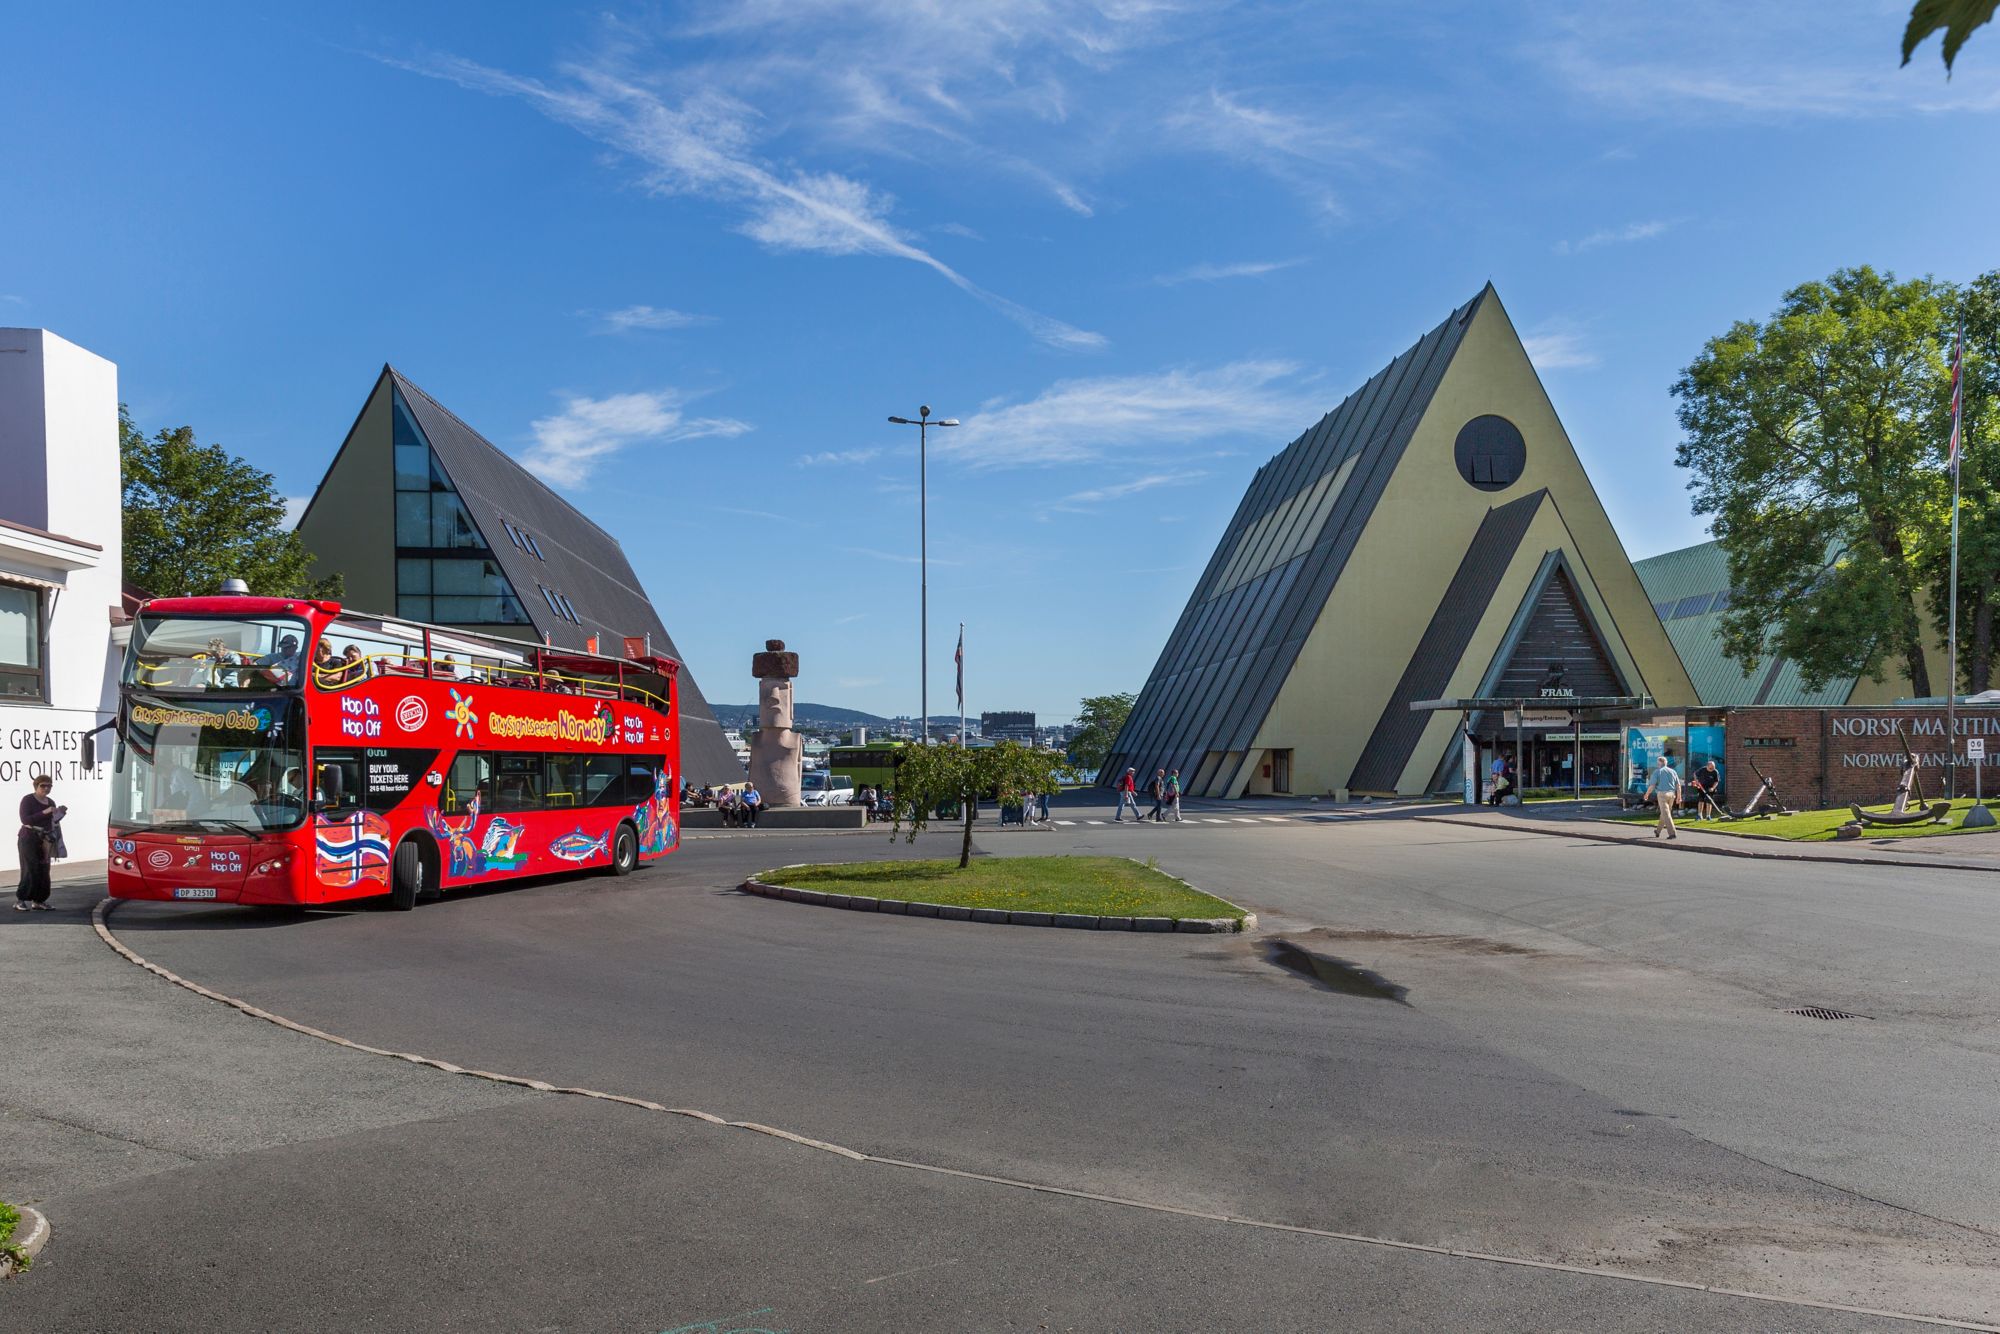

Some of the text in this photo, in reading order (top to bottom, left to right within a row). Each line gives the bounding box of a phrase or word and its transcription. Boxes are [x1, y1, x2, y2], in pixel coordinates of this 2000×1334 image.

[1541, 688, 1573, 697] FRAM
[341, 696, 379, 715] Hop On
[225, 709, 259, 731] Oslo
[342, 718, 381, 736] Hop Off
[624, 715, 643, 729] Hop On
[1832, 717, 1904, 736] NORSK
[558, 709, 606, 746] Norway
[625, 731, 635, 744] Hop
[1843, 752, 1946, 768] NORWEAN
[0, 760, 21, 782] OF
[29, 760, 63, 781] OUR
[369, 764, 399, 774] BUY YOUR
[370, 774, 409, 784] TICKETS HERE
[210, 851, 240, 861] Hop On
[211, 863, 242, 872] Hop Off
[180, 889, 214, 897] DP 32510
